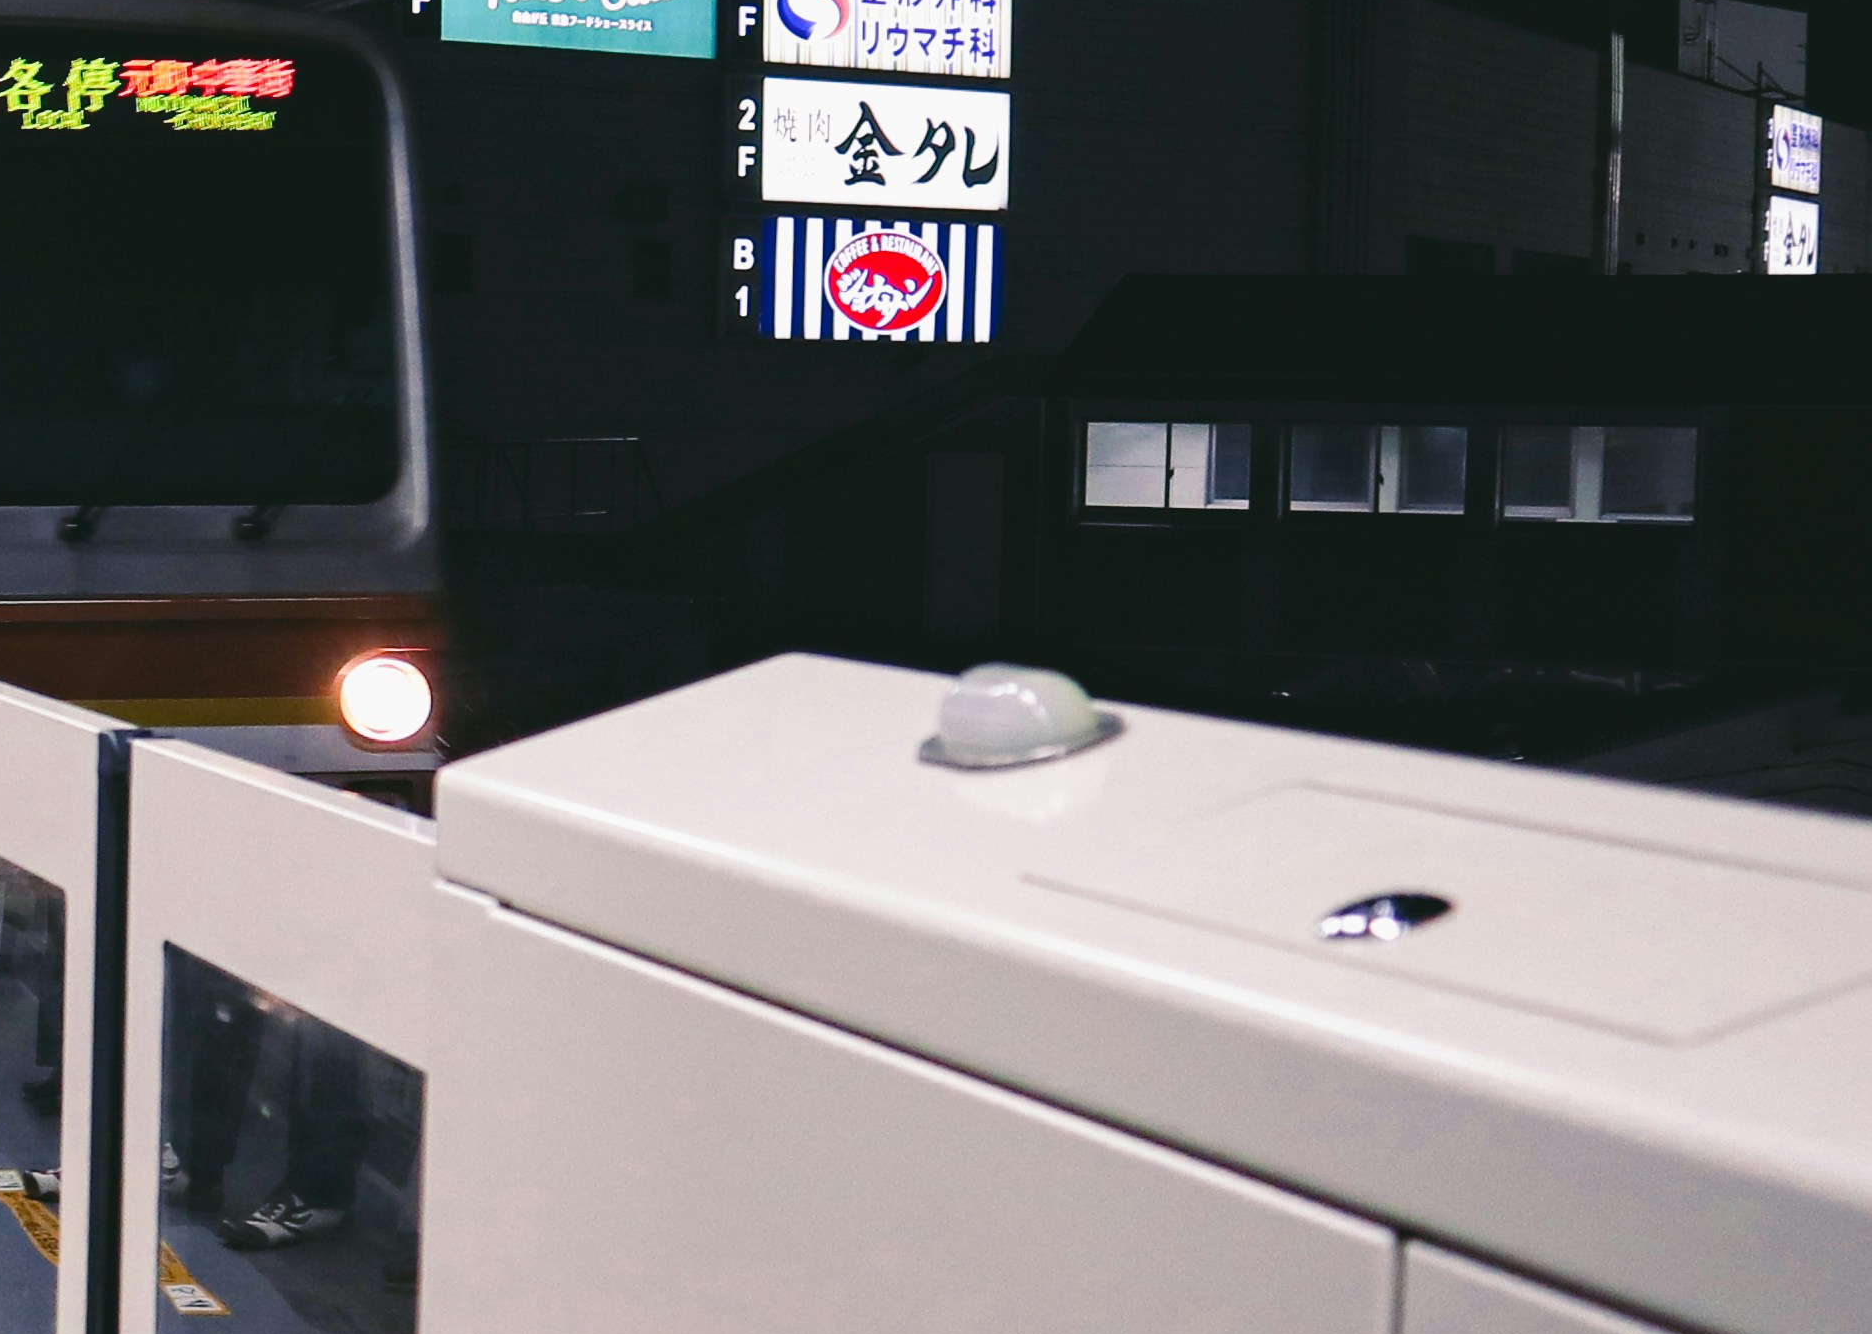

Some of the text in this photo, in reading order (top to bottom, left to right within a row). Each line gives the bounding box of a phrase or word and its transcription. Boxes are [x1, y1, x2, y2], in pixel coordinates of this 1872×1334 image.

[859, 21, 997, 65] リウマチ科
[772, 100, 1000, 188] 焼肉 金タレ
[833, 237, 871, 273] COFFEE
[835, 268, 934, 328] ジョナサン
